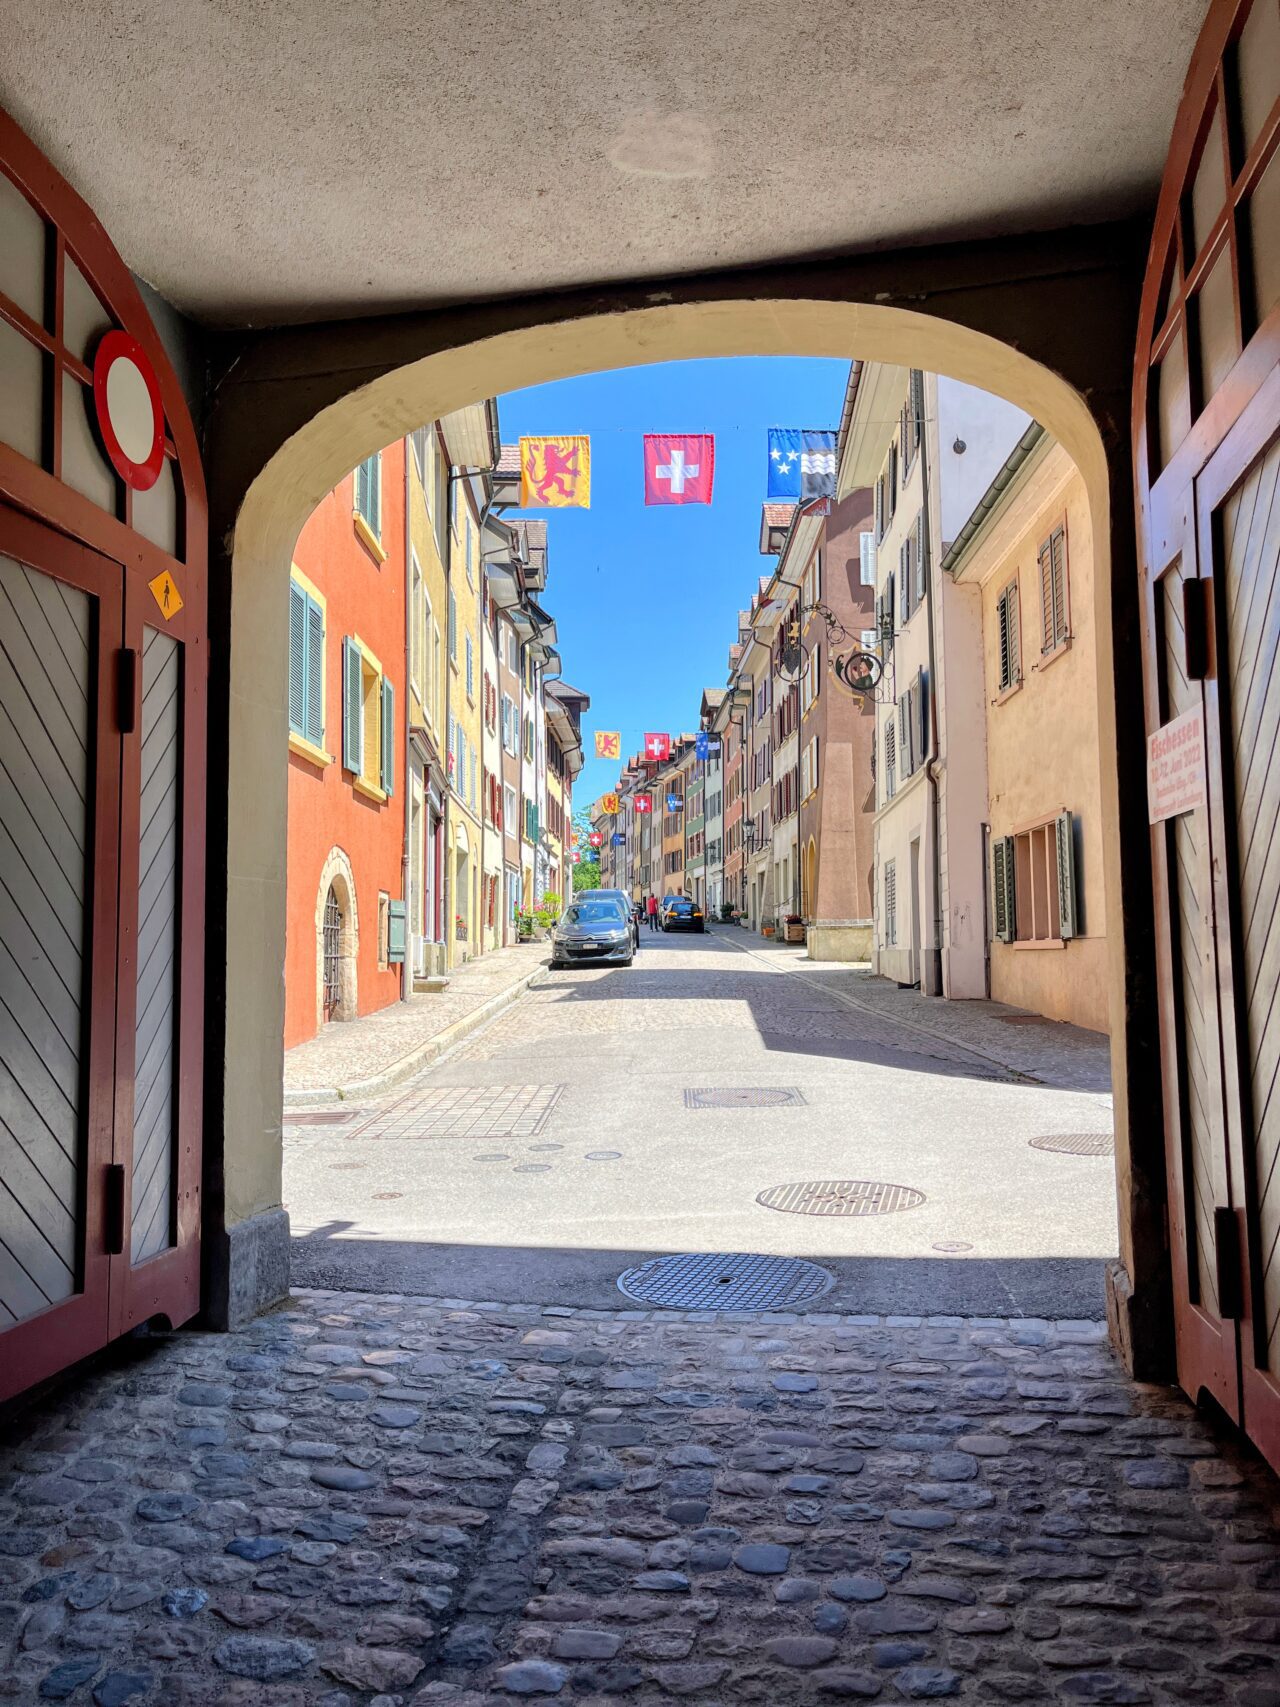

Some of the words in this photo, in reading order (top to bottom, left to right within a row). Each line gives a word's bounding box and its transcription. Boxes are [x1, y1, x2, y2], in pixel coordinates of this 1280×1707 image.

[1152, 718, 1199, 761] Fischessen
[1170, 754, 1183, 775] Juni
[1183, 743, 1201, 768] 2022
